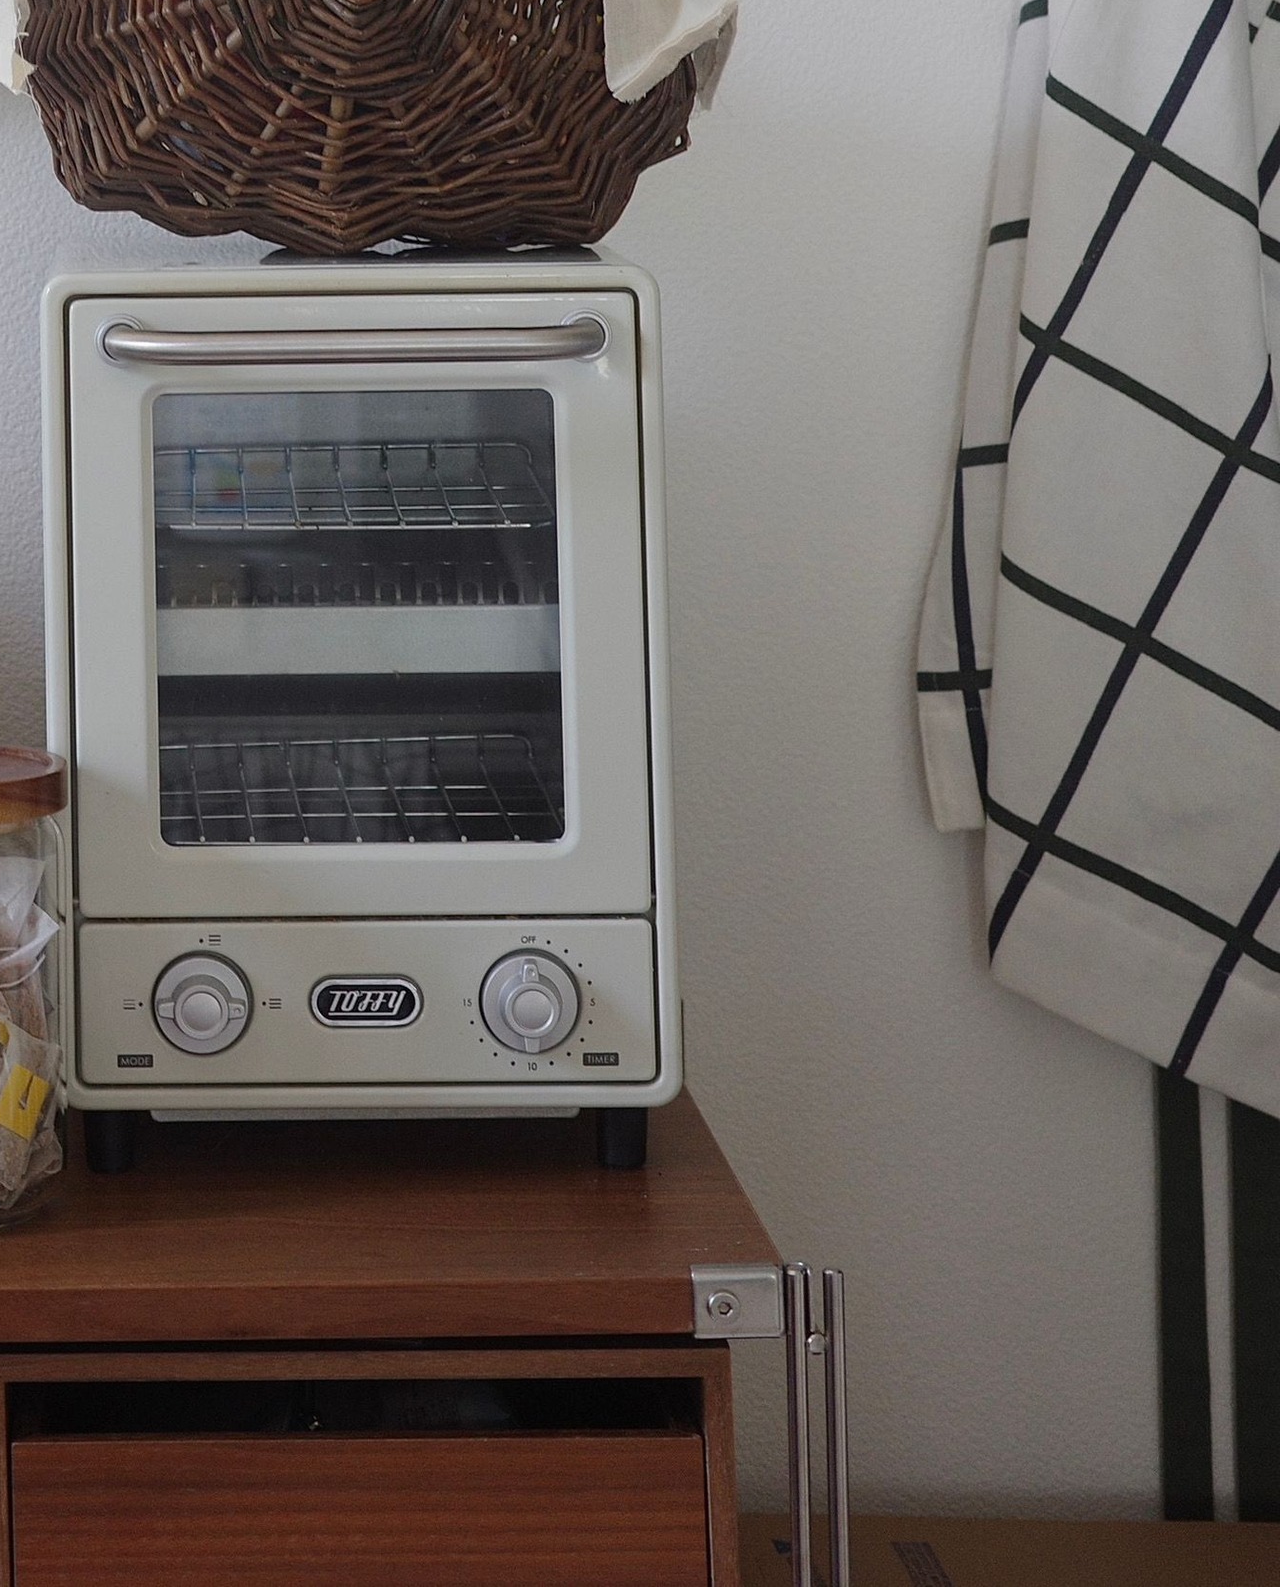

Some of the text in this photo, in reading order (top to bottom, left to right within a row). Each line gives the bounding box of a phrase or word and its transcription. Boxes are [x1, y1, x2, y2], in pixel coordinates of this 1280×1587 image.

[520, 935, 536, 944] OFF
[463, 998, 473, 1007] 15
[589, 997, 596, 1007] 5
[120, 1056, 151, 1066] MODE
[587, 1054, 616, 1064] TIMER
[527, 1062, 538, 1071] 10
